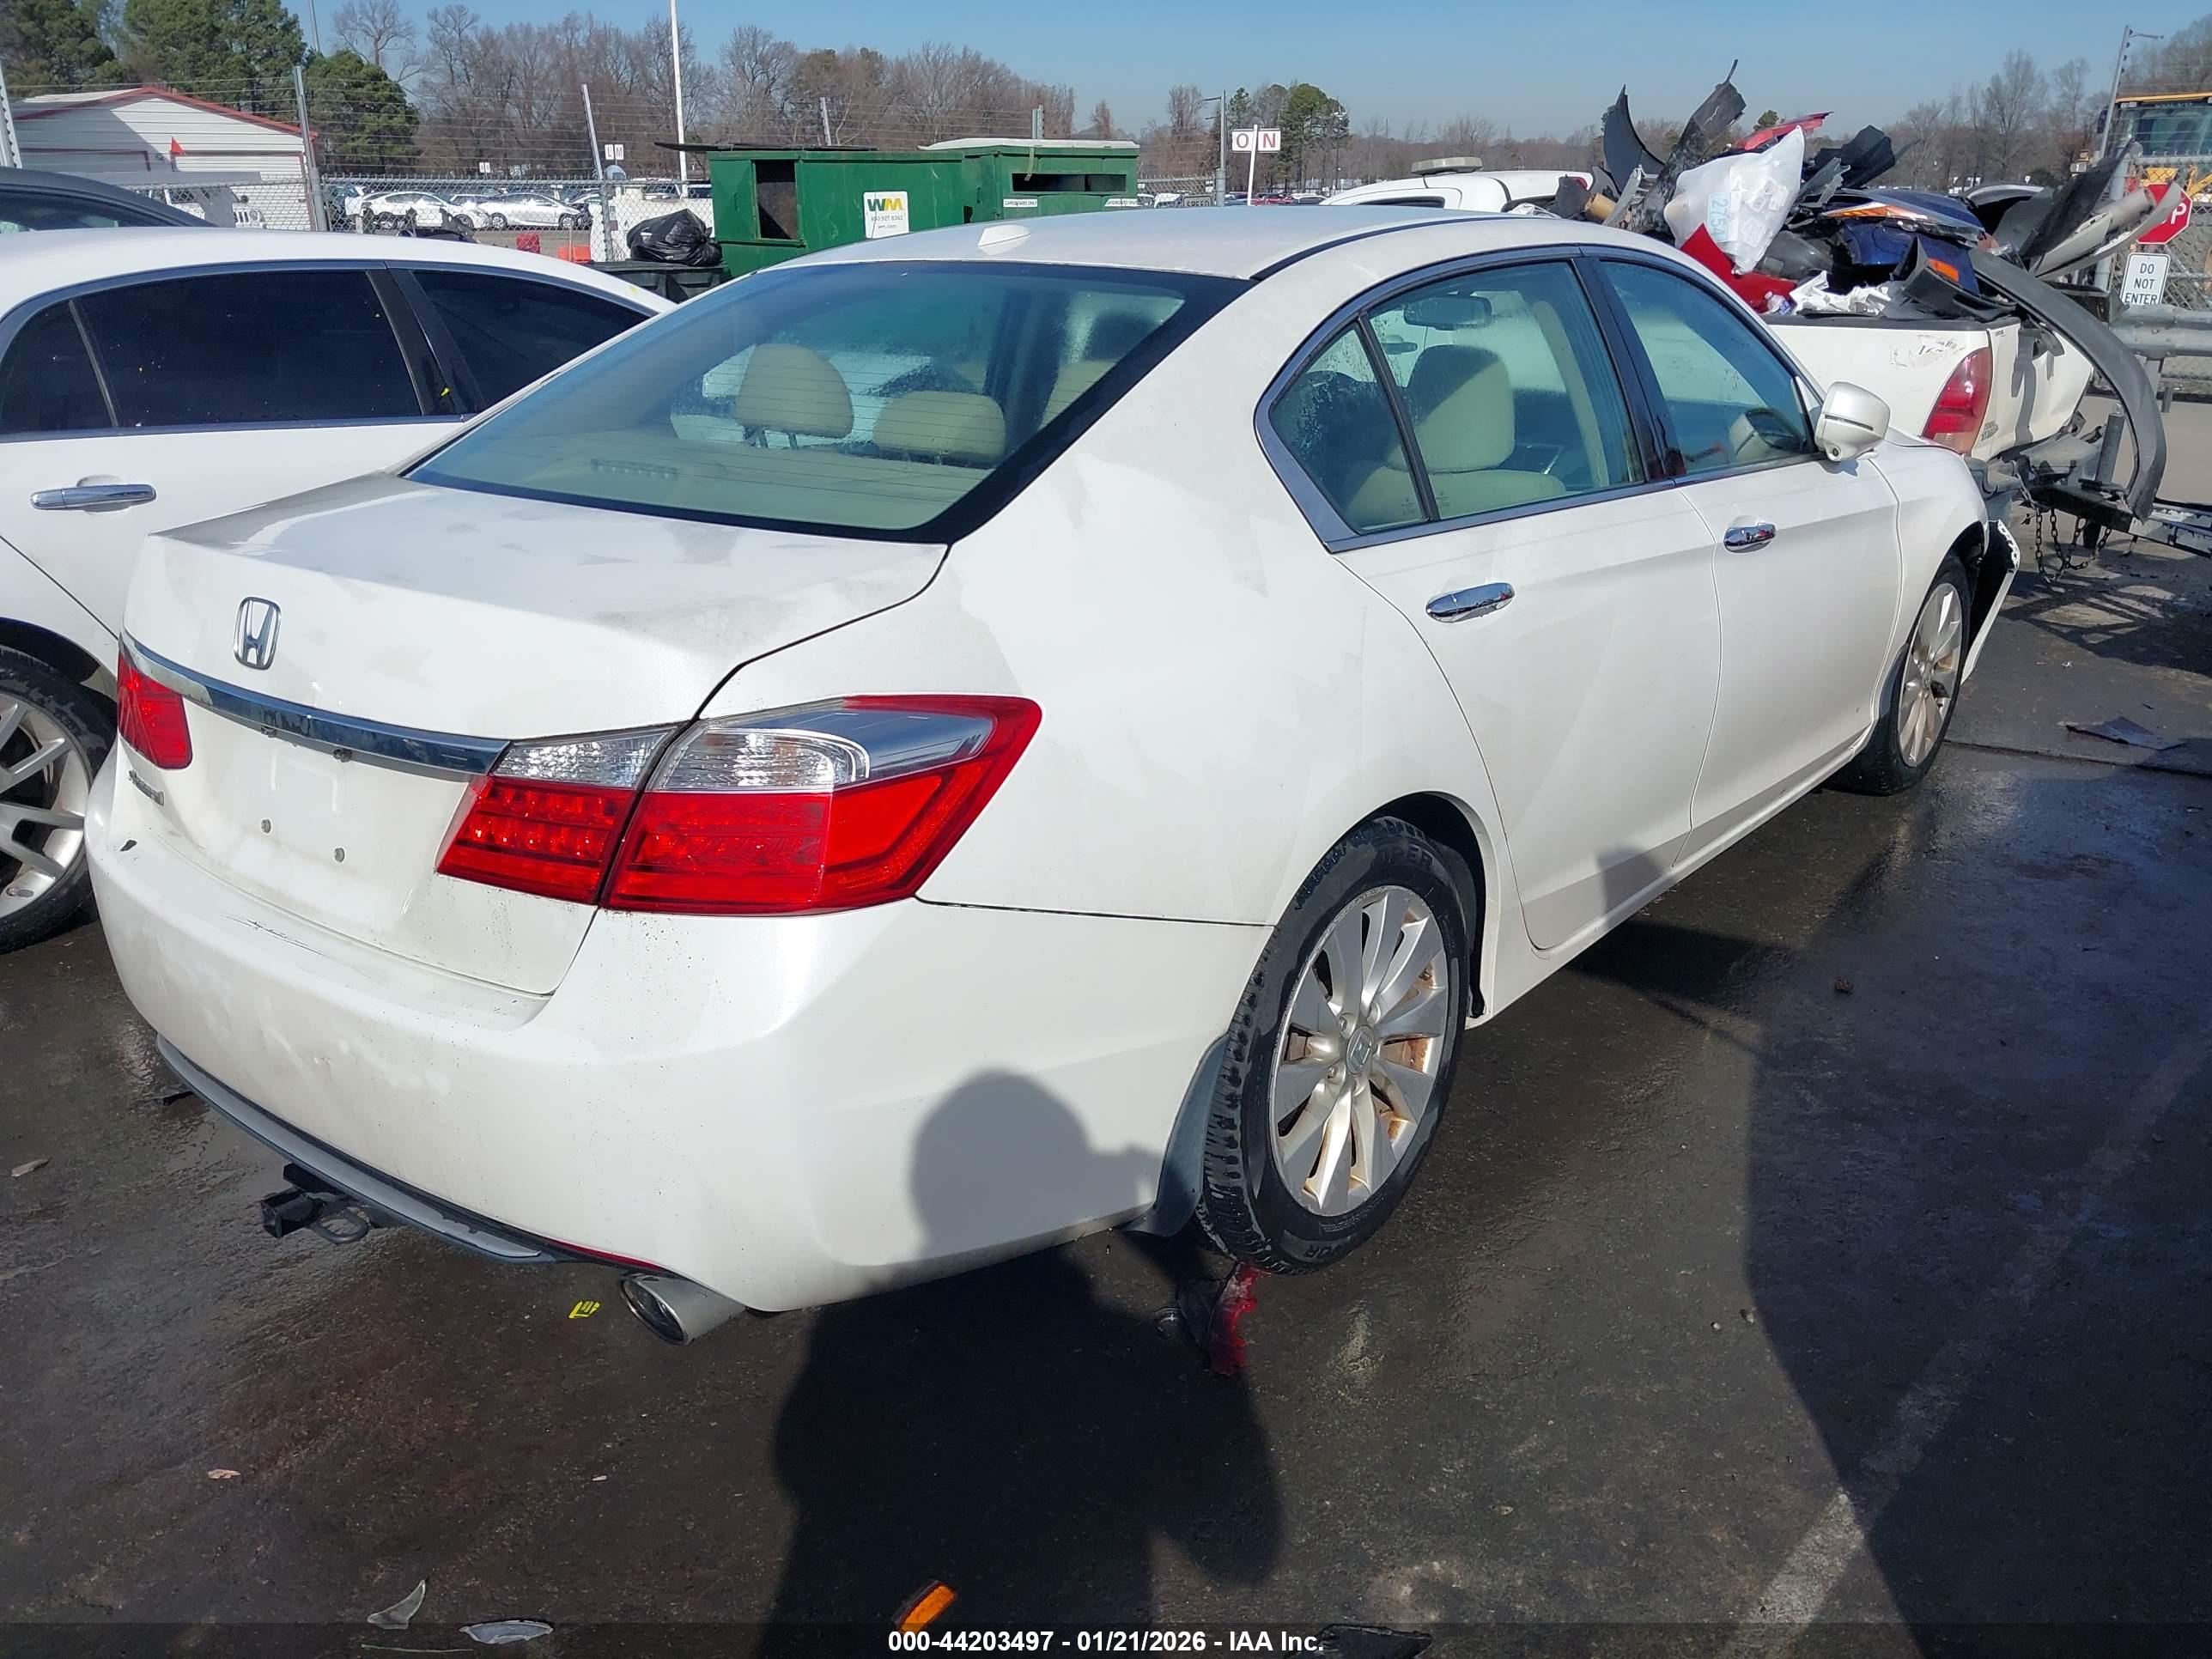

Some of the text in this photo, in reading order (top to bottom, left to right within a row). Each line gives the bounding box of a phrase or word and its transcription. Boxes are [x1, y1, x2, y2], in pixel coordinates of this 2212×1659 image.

[1236, 132, 1276, 149] O N
[866, 198, 905, 212] WM
[2139, 263, 2155, 274] DO
[2133, 278, 2155, 289] NOT
[2124, 292, 2158, 305] ENTER
